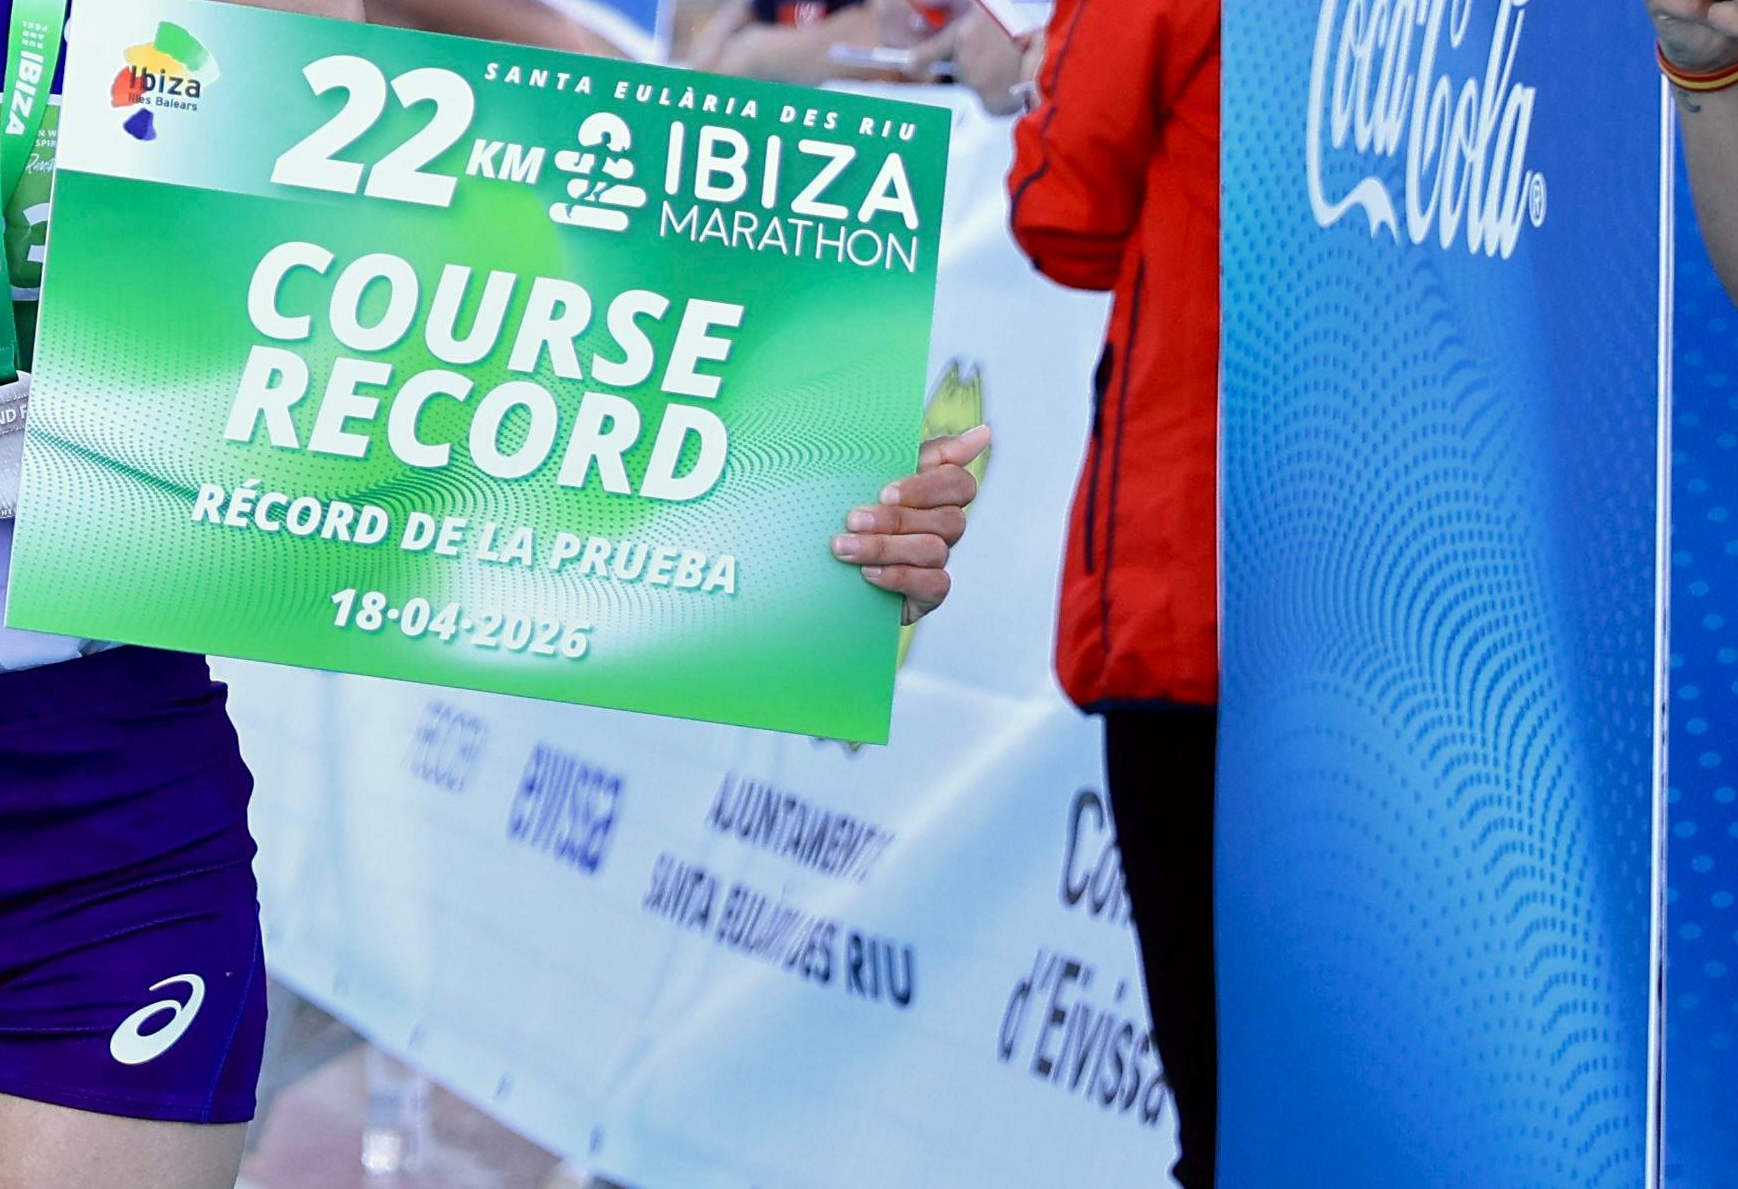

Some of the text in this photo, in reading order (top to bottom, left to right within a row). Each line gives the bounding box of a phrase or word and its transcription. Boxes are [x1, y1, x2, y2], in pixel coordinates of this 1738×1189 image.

[5, 50, 44, 134] IBIZA
[129, 65, 201, 98] Ibiza
[155, 96, 198, 111] Balears
[484, 62, 917, 142] SANTA EULÀRIA DES RIU
[270, 54, 545, 208] 22 KM
[664, 121, 919, 231] IBIZA
[659, 201, 918, 273] MARATHON
[245, 240, 745, 399] COURSE
[222, 343, 728, 503] RECORD
[190, 482, 739, 597] RÉCORD DE LA PRUEBA
[844, 927, 915, 1007] RIU
